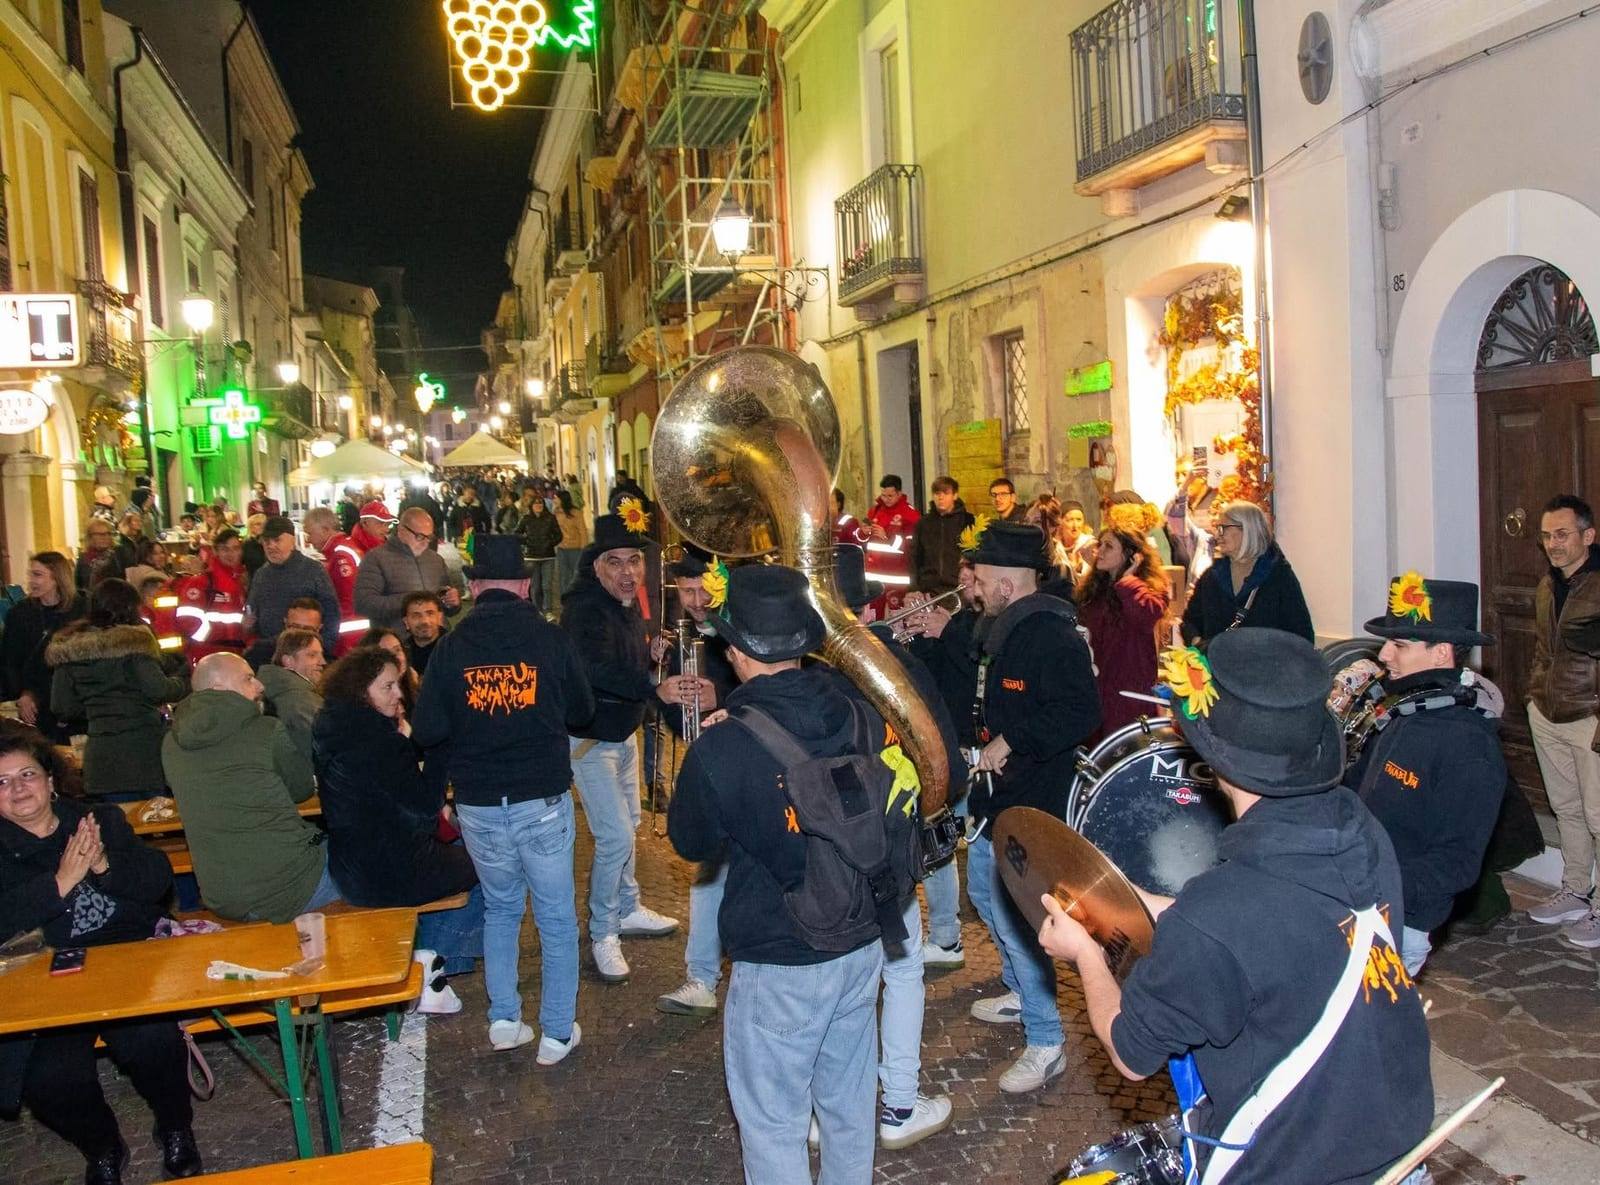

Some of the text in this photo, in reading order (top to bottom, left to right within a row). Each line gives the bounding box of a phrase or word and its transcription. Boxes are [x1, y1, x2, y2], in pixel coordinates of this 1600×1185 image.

[1393, 275, 1405, 291] 85
[464, 662, 536, 684] TAKABUM
[1168, 790, 1200, 802] TAKABUM
